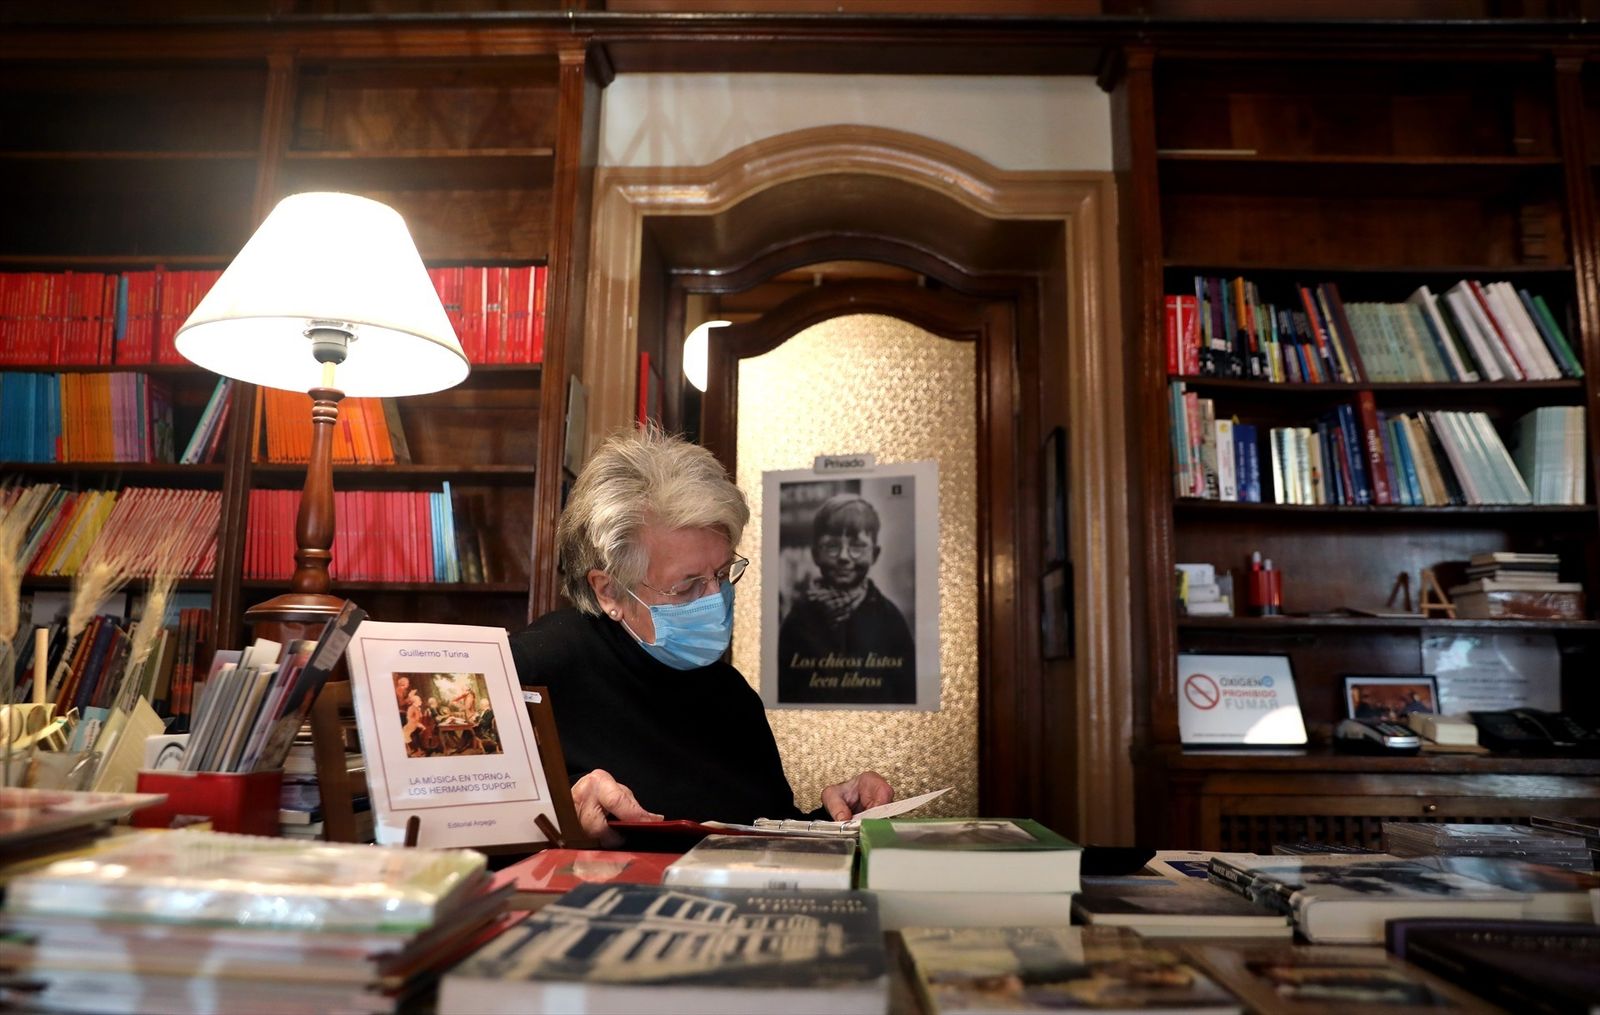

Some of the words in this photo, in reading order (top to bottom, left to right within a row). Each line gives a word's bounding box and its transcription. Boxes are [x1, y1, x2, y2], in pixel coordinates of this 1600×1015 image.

[824, 457, 865, 468] Privado
[399, 649, 441, 658] Guillermo
[443, 649, 470, 658] Turina
[790, 652, 816, 667] Los
[818, 652, 862, 667] chicos
[865, 651, 903, 667] listos
[809, 671, 839, 687] leen
[841, 671, 883, 687] libros
[1222, 689, 1278, 698] PROHIBIDO
[409, 777, 421, 785] LA
[458, 774, 471, 782] EN
[473, 772, 504, 781] TORNO
[408, 787, 428, 796] LOS
[429, 784, 481, 794] HERMANOS
[482, 781, 517, 791] DUPORT
[447, 820, 473, 829] Editorial
